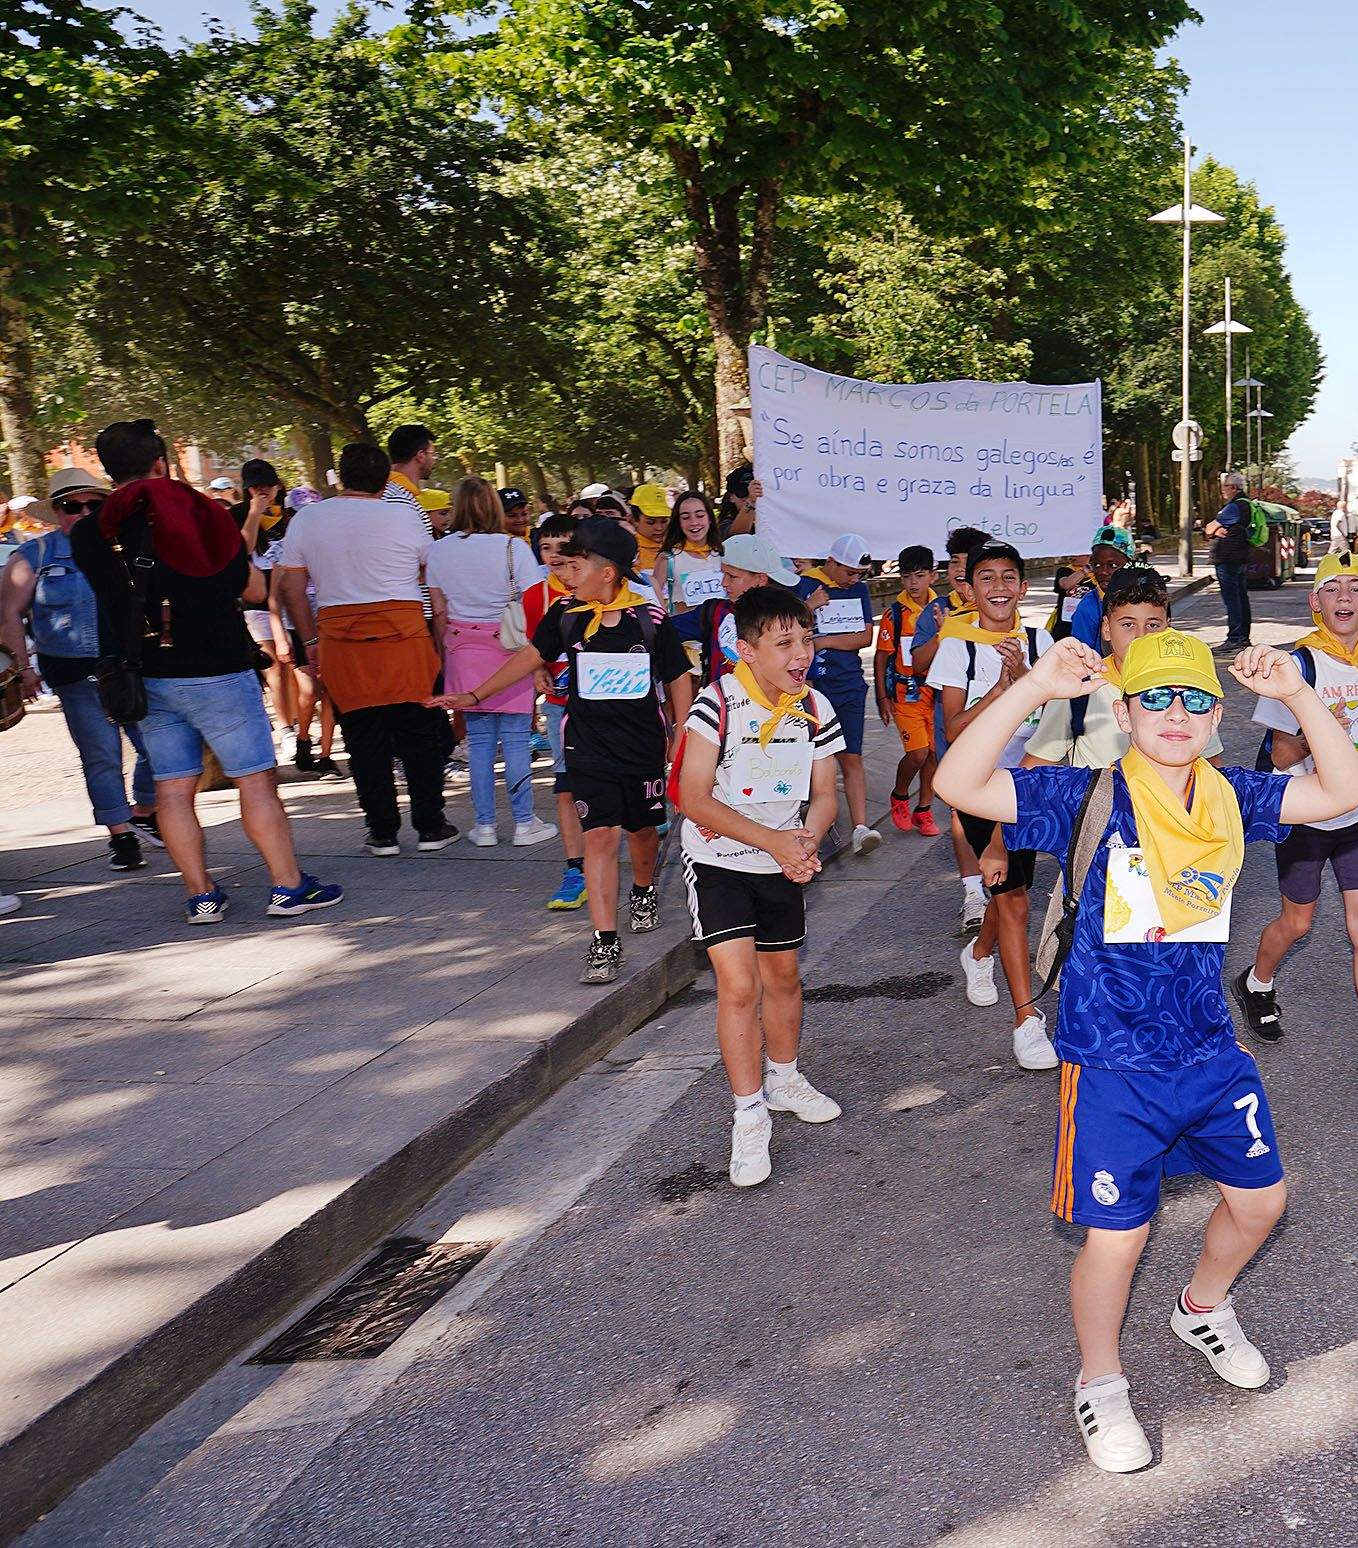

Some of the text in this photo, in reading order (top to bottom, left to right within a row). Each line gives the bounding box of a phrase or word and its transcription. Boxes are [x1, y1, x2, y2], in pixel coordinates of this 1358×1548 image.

[758, 362, 1093, 416] CEP MARCOS da PORTELA
[817, 428, 883, 458] aínda
[894, 441, 964, 463] somos
[1082, 443, 1095, 465] é
[772, 467, 803, 490] por
[818, 465, 865, 492] obra
[876, 478, 888, 493] e
[897, 478, 957, 502] graza
[969, 477, 993, 498] da
[946, 514, 1038, 538] Ctelao
[643, 779, 665, 799] 10
[1233, 1092, 1262, 1139] 7
